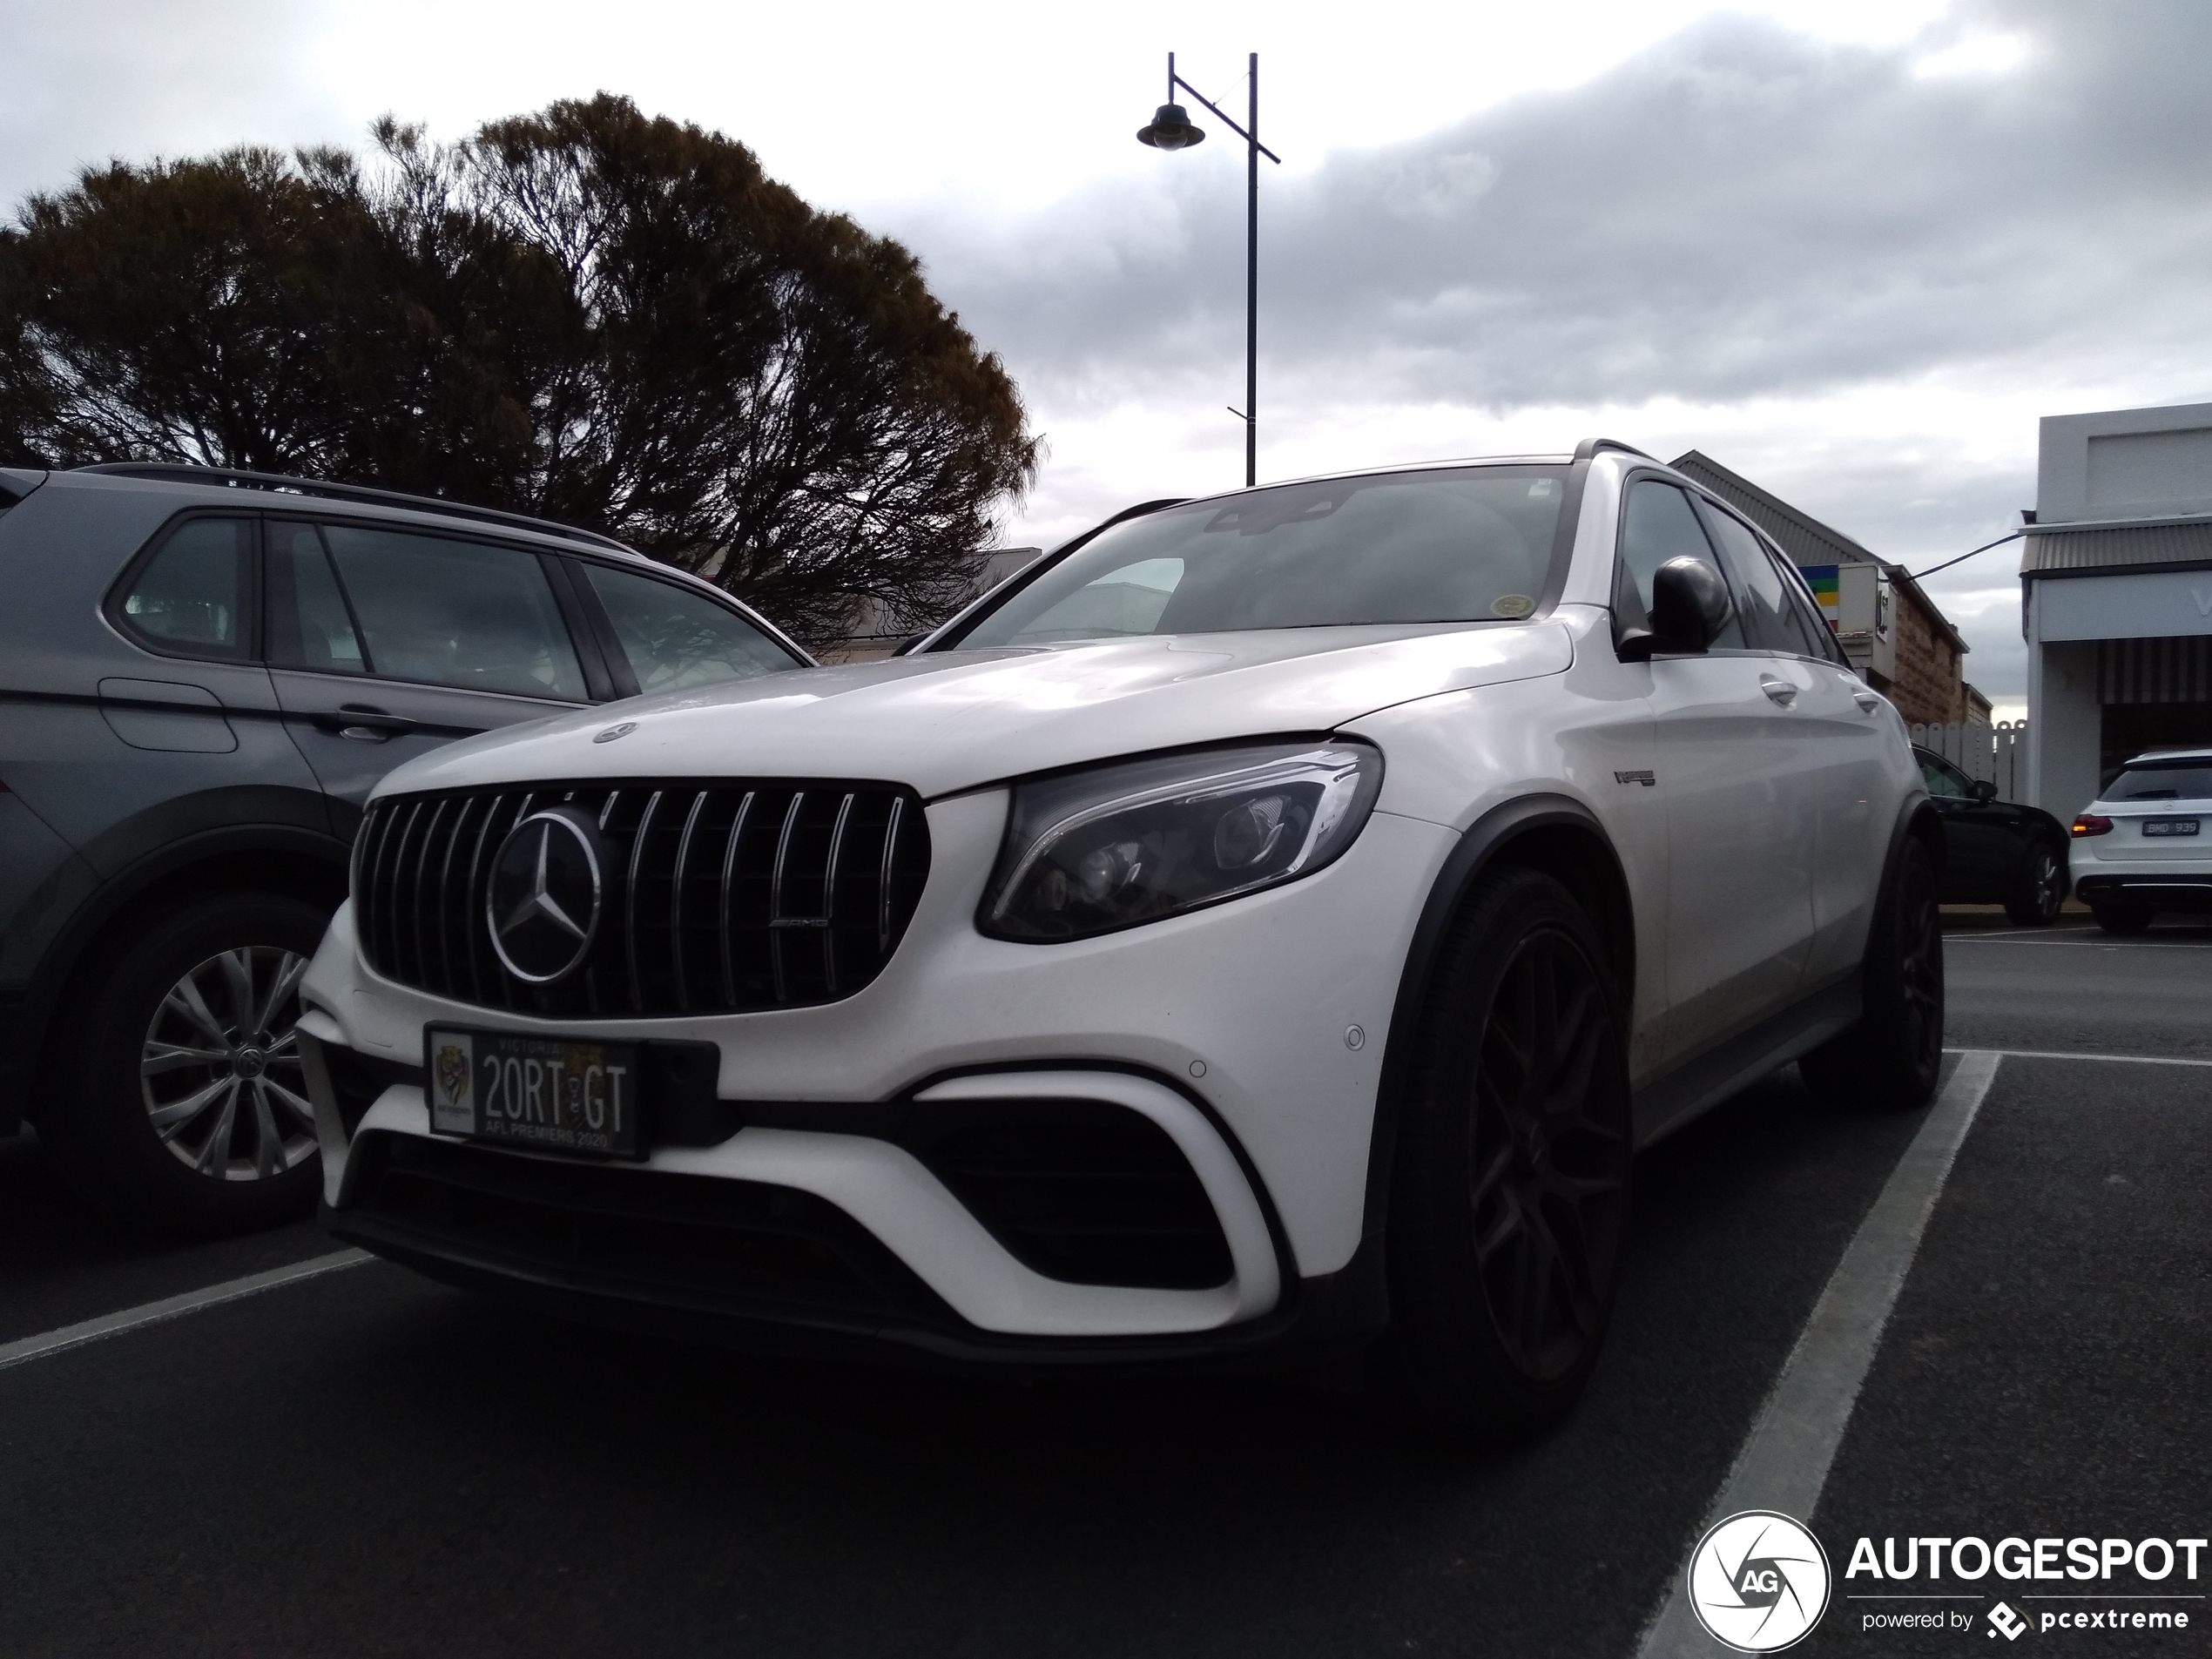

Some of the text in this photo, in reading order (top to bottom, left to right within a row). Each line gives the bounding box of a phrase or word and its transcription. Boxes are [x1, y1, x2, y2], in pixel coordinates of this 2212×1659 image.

[2175, 823, 2196, 833] 939
[786, 919, 828, 927] AMG
[498, 1037, 559, 1055] VICTORIA
[584, 1064, 626, 1132] GT
[485, 1120, 607, 1148] AFL PREMIERS 2020
